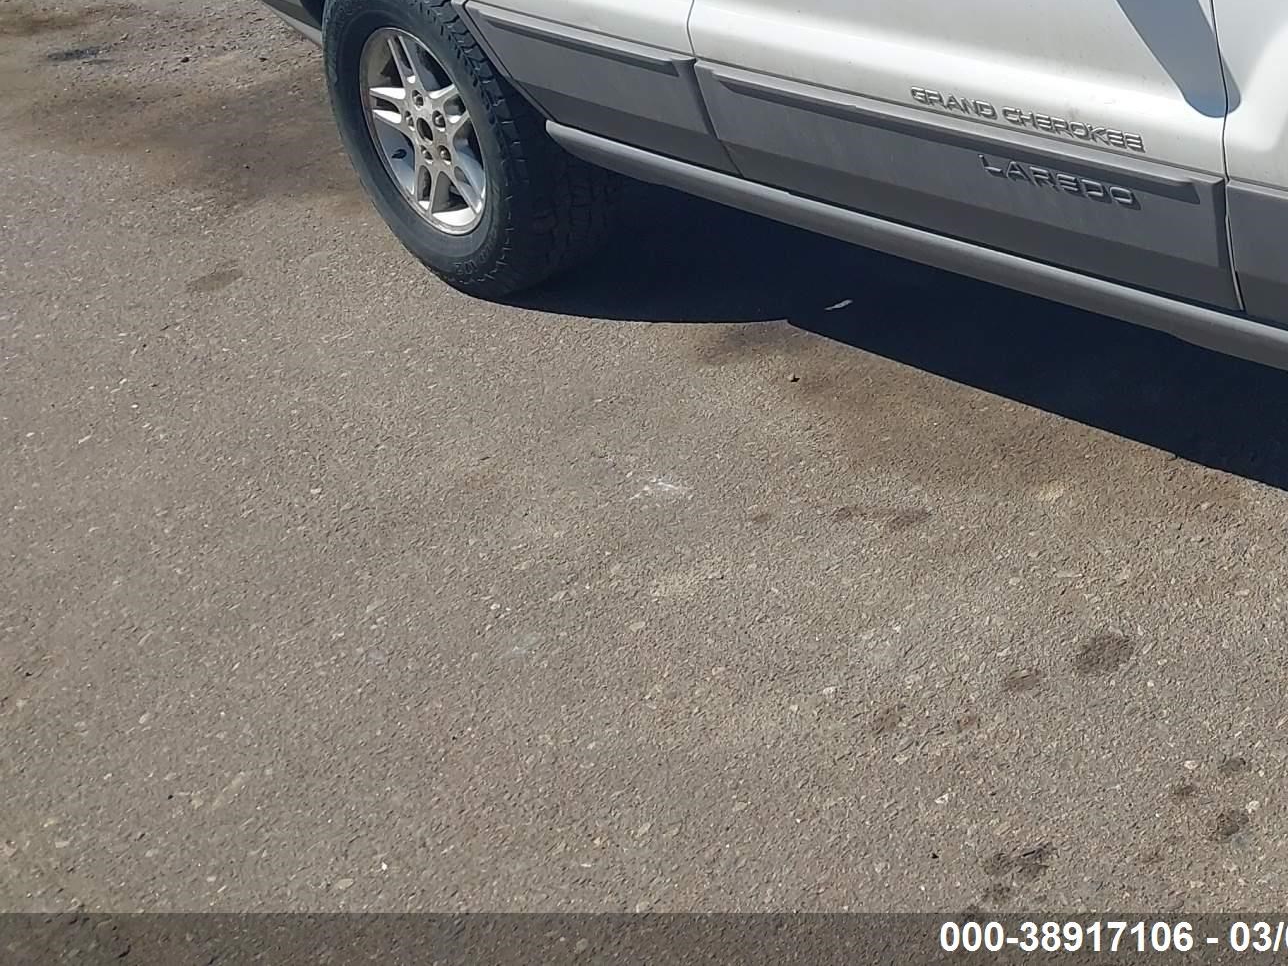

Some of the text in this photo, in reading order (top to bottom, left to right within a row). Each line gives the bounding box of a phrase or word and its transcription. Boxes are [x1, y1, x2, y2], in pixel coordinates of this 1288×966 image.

[910, 85, 1146, 154] GRAND CHEROKEE
[978, 153, 1142, 211] LAREDO
